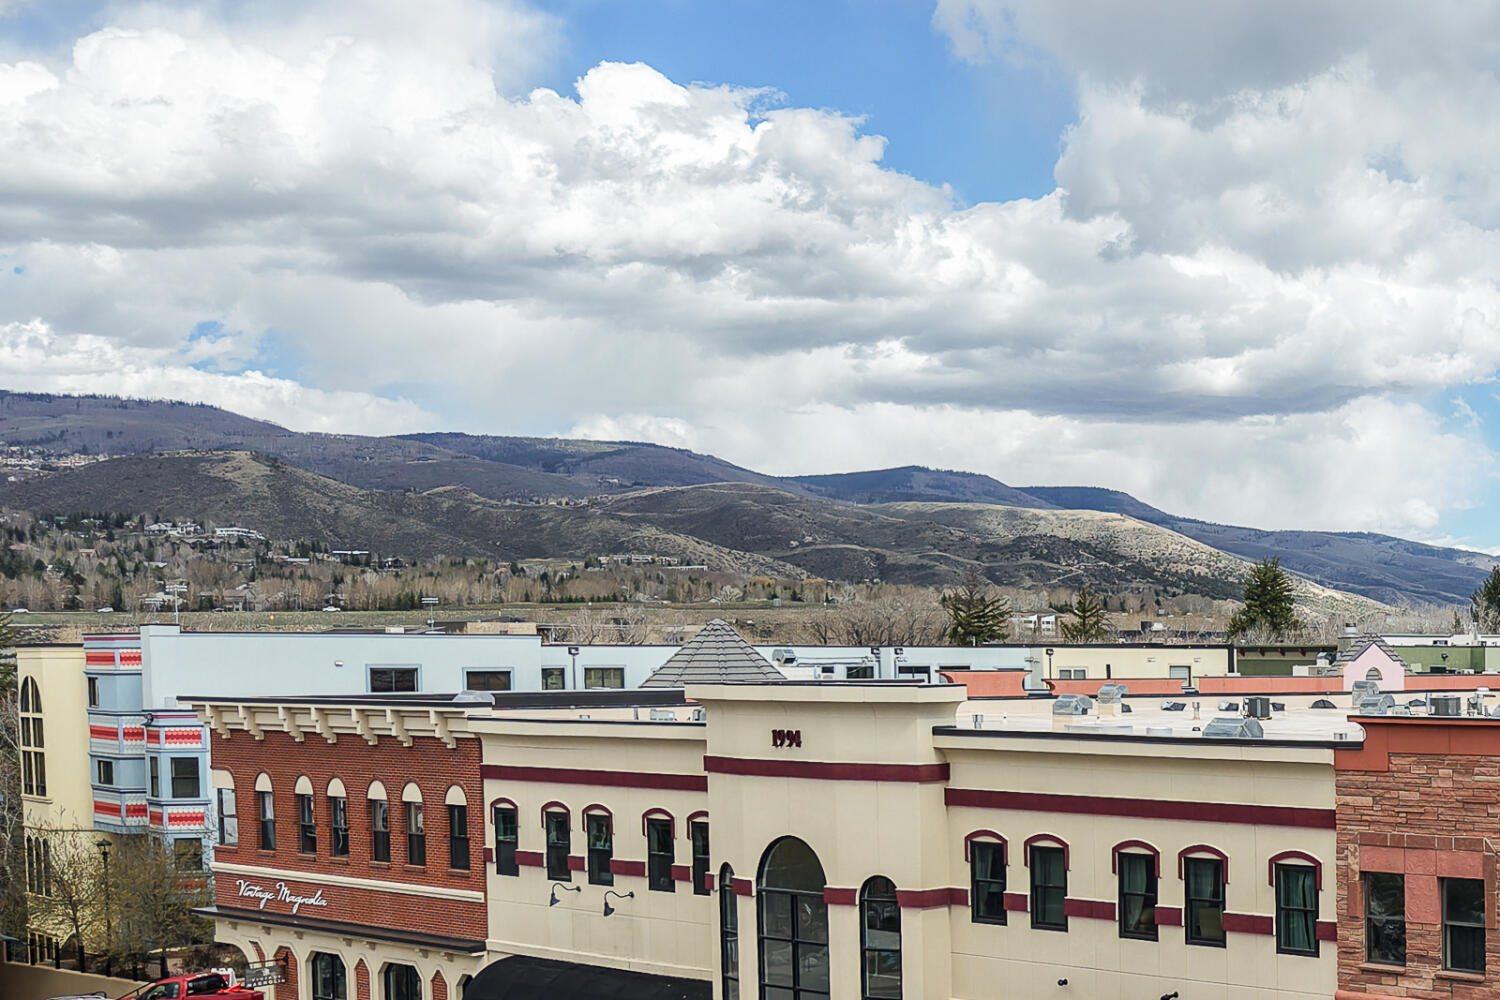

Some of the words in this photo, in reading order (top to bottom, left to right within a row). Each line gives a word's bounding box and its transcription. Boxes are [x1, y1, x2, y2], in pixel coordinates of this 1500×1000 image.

[772, 729, 802, 748] 1994
[236, 880, 275, 909] Vintage
[276, 882, 327, 914] Magnolia
